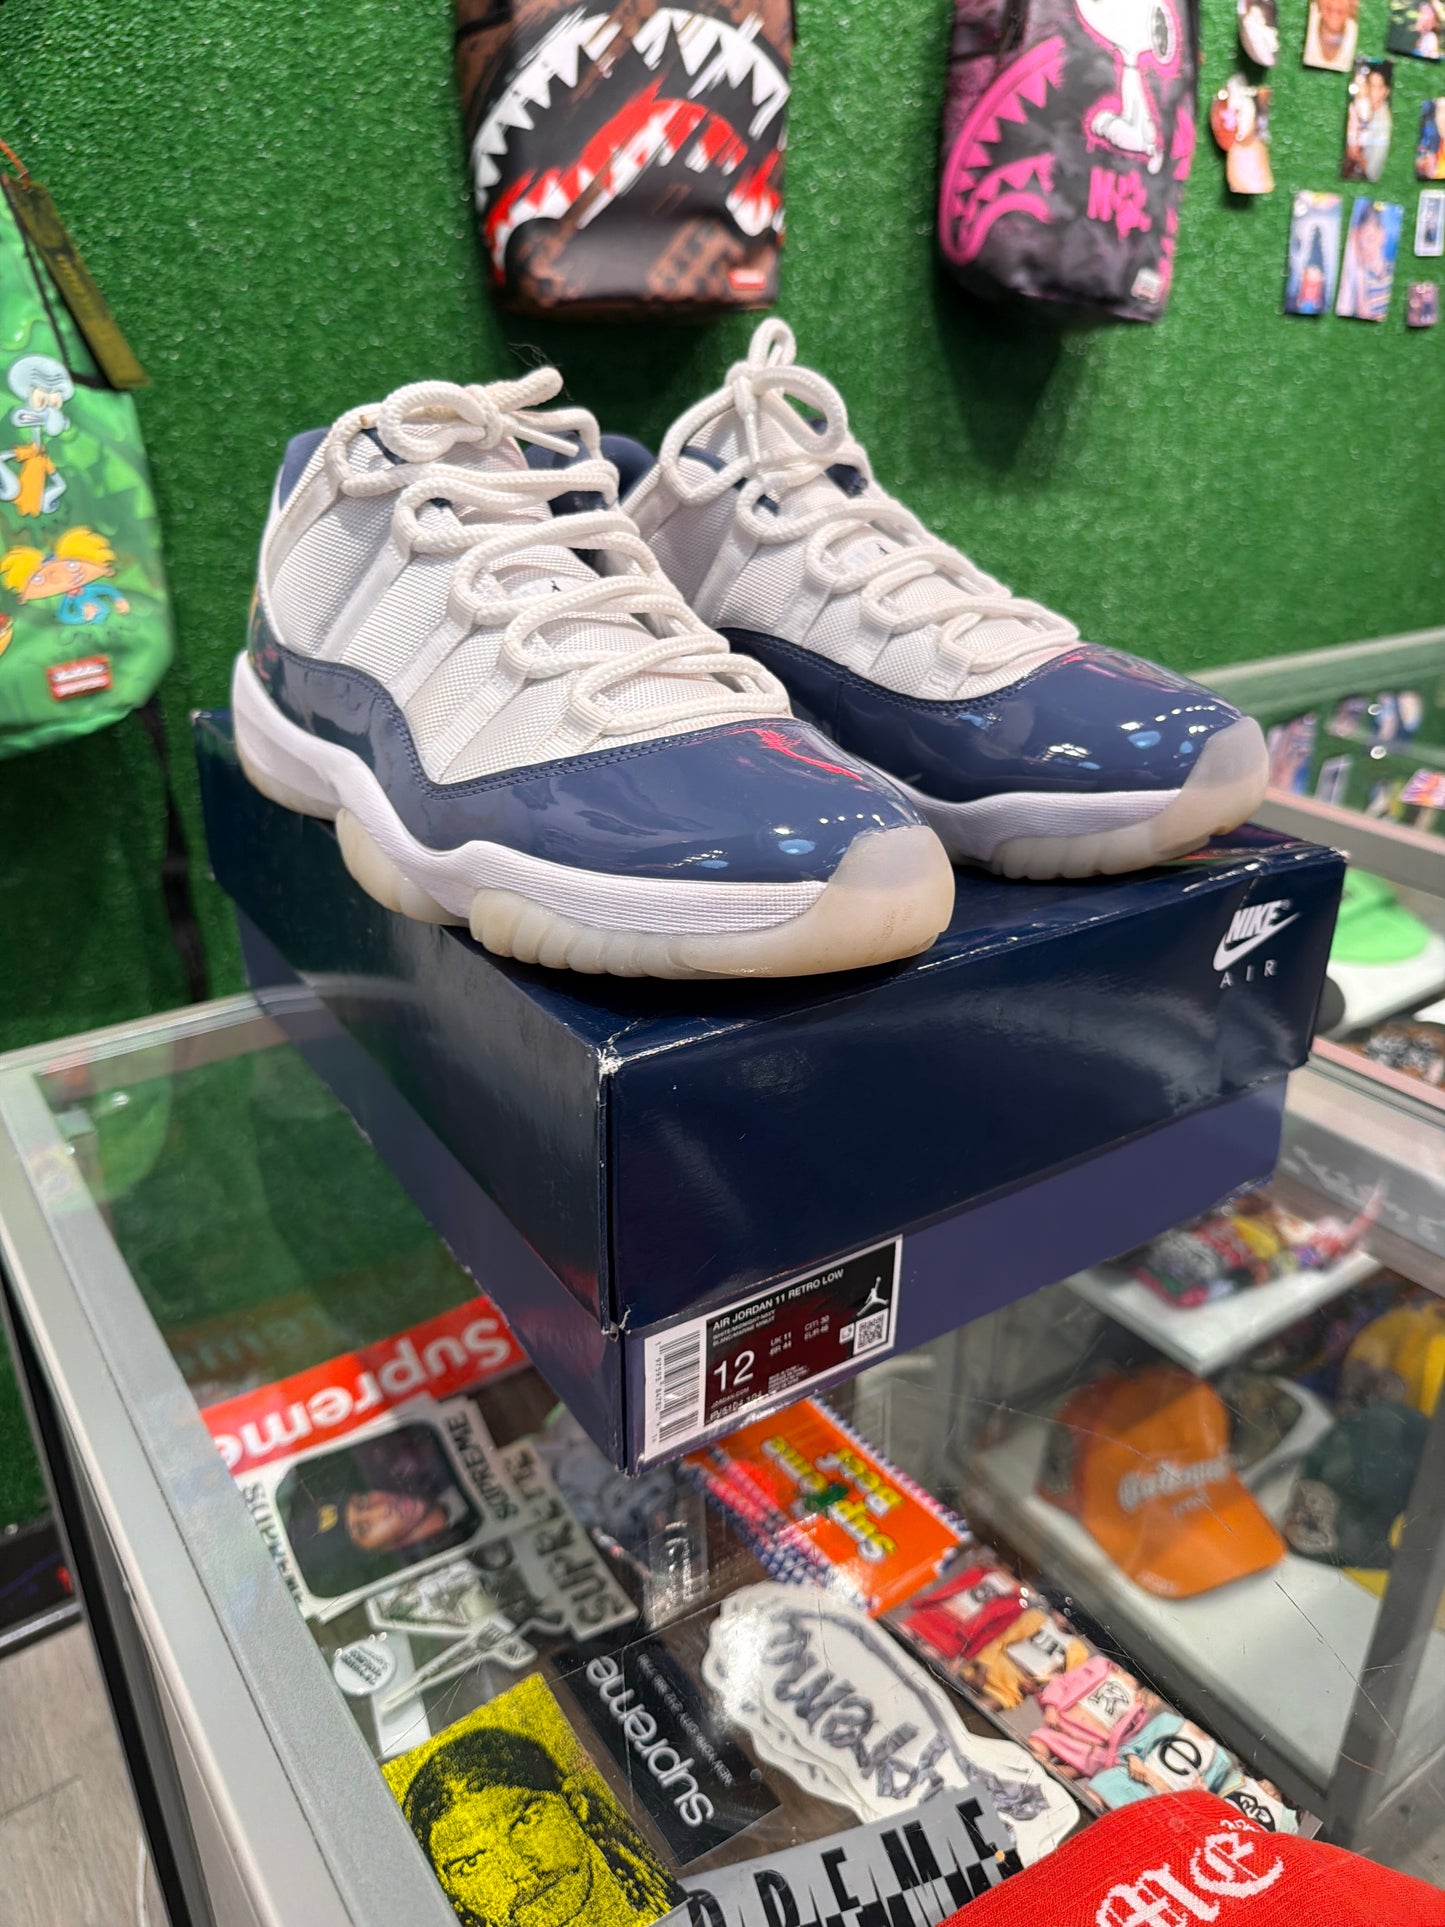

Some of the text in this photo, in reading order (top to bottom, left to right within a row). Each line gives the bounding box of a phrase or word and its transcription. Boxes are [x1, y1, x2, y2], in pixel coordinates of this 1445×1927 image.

[1225, 899, 1282, 944] NIKE
[1219, 959, 1278, 989] AIR
[713, 1268, 844, 1331] AIR JORDAN 11 RETRO LOW
[770, 1332, 792, 1348] UK 11
[804, 1327, 820, 1342] EUR
[215, 1317, 511, 1466] Supreme
[713, 1350, 755, 1393] 12
[448, 1411, 518, 1520] SUPREME
[761, 1436, 897, 1563] Supeme
[586, 1656, 714, 1828] supreme
[695, 1733, 717, 1761] YORK
[714, 1760, 735, 1786] NEW
